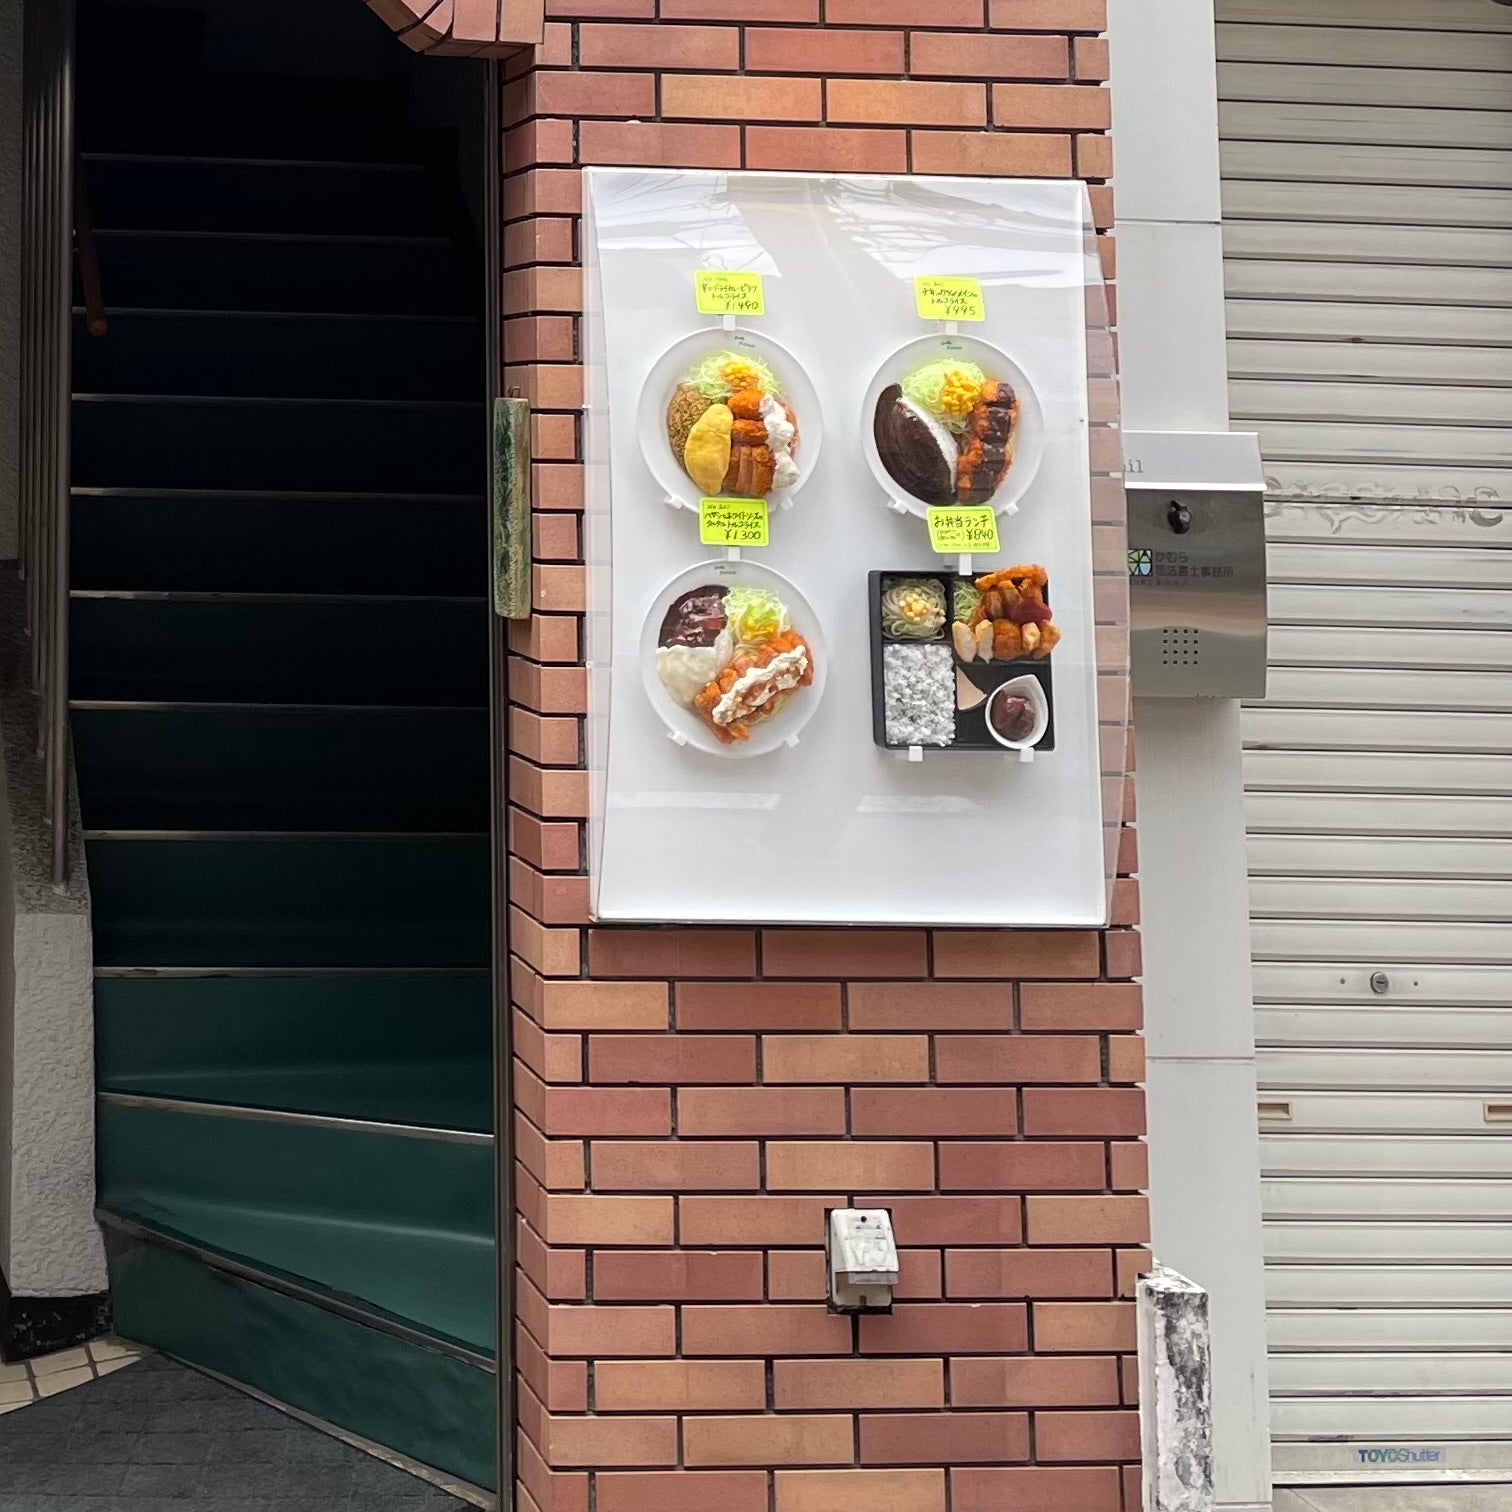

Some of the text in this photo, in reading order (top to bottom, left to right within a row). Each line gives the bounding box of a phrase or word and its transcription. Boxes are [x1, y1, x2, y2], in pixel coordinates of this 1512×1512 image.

[934, 515, 990, 528] お弁当ランチ
[724, 529, 762, 540] ¥1300
[966, 529, 994, 540] ¥840
